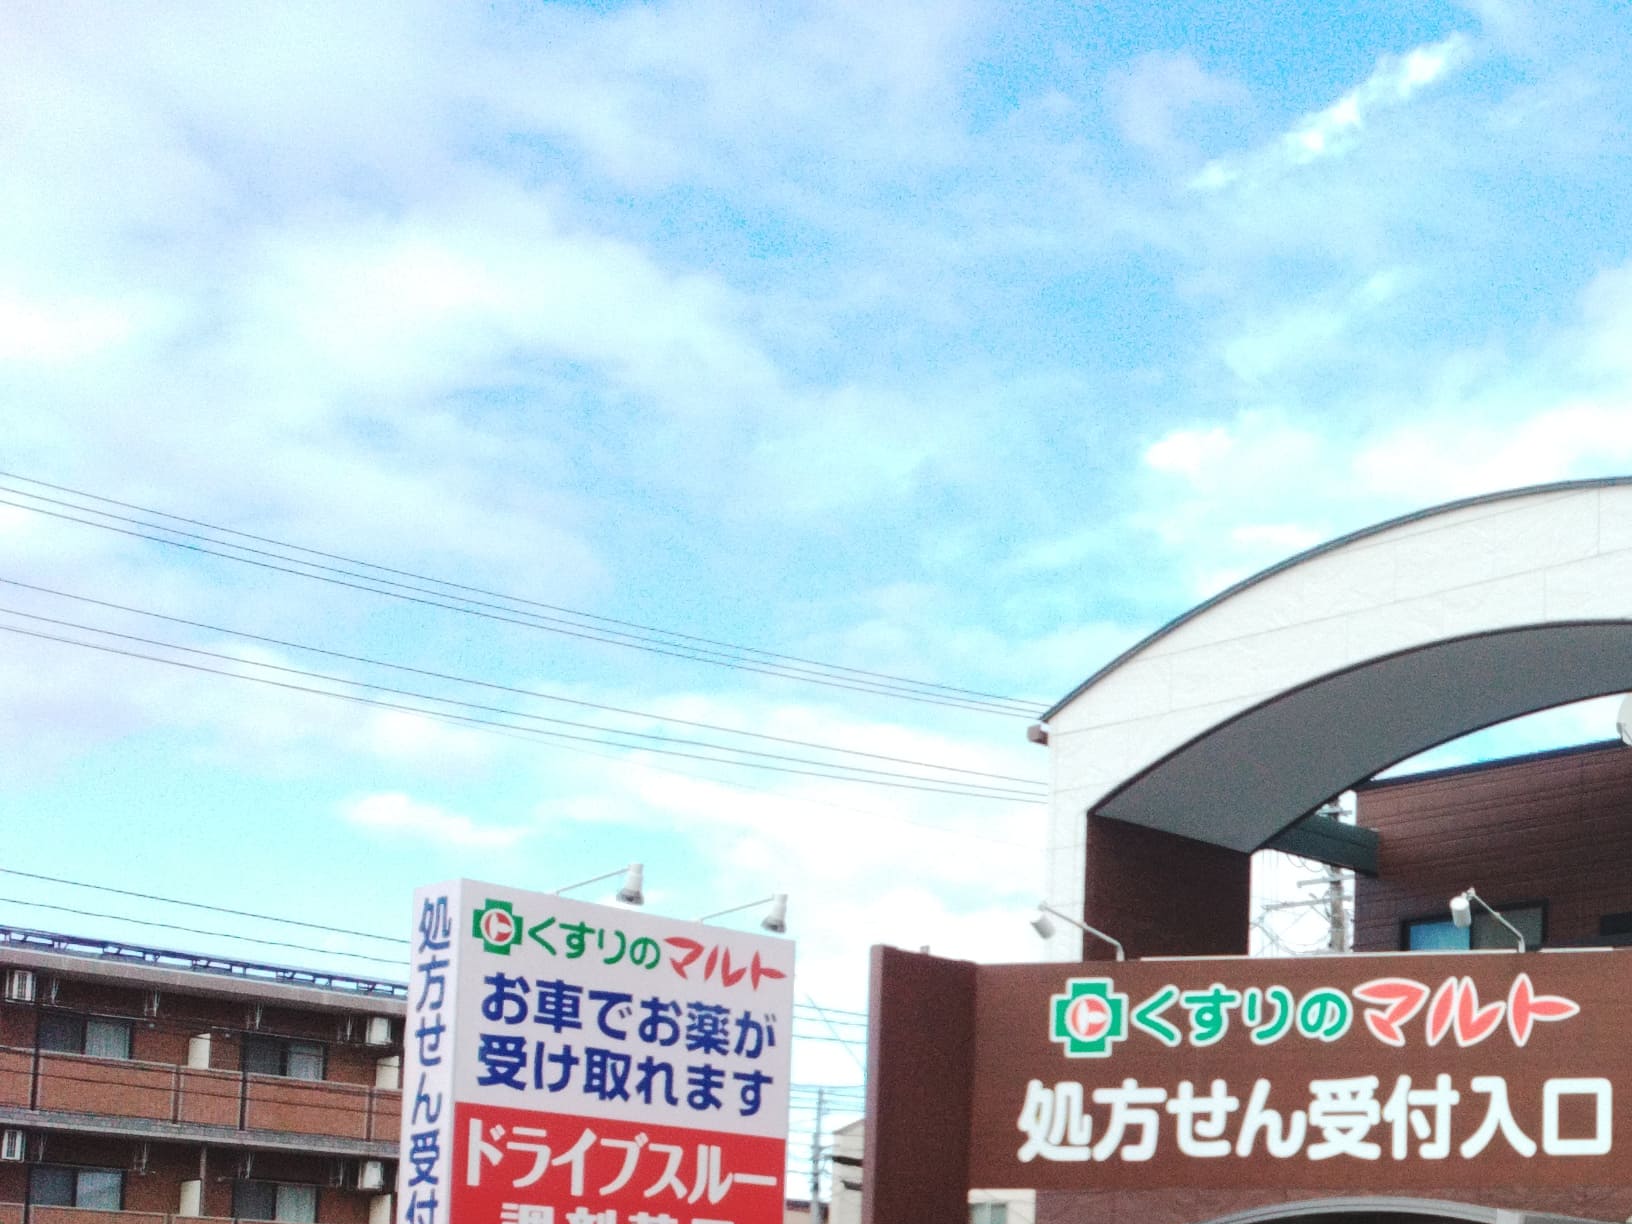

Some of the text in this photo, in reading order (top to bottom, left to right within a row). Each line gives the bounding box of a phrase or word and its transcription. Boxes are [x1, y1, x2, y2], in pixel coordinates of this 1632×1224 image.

[527, 916, 788, 992] くすりのマルト
[481, 972, 777, 1059] お車でお薬が
[1129, 973, 1581, 1048] くすりのマルト
[476, 1033, 774, 1117] 受け取れます
[1017, 1073, 1614, 1162] 処方せん受付入口
[466, 1117, 777, 1205] ドライブスルー
